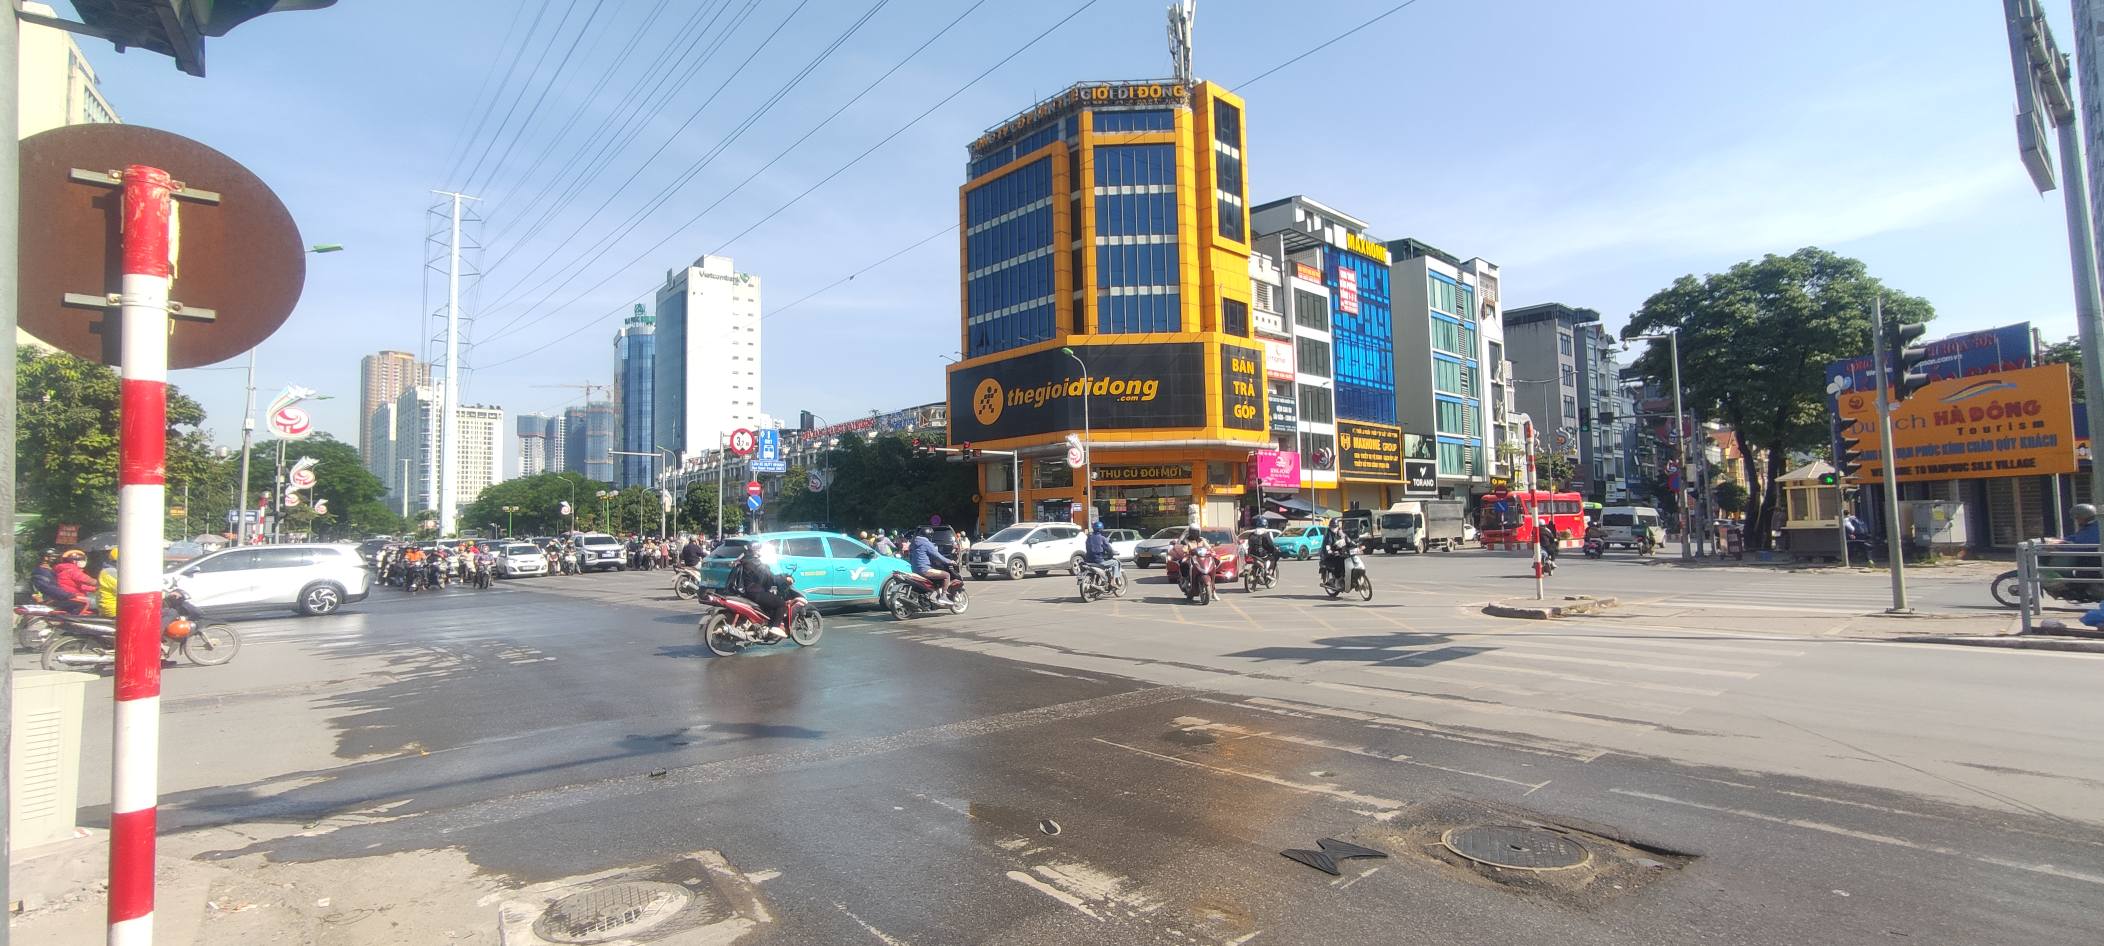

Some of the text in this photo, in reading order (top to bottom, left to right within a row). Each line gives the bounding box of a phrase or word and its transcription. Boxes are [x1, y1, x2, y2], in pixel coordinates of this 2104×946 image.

[1232, 356, 1255, 375] BÁN
[1007, 376, 1159, 408] thegioididong
[1232, 378, 1256, 397] TRẢ
[1233, 400, 1257, 420] GÓP
[1933, 404, 1967, 427] HÀ
[1956, 419, 2045, 436] Tourism
[1100, 469, 1121, 479] THU
[1971, 460, 1993, 472] SILK
[1995, 457, 2037, 470] VILLAGE
[1413, 478, 1434, 487] TORANO
